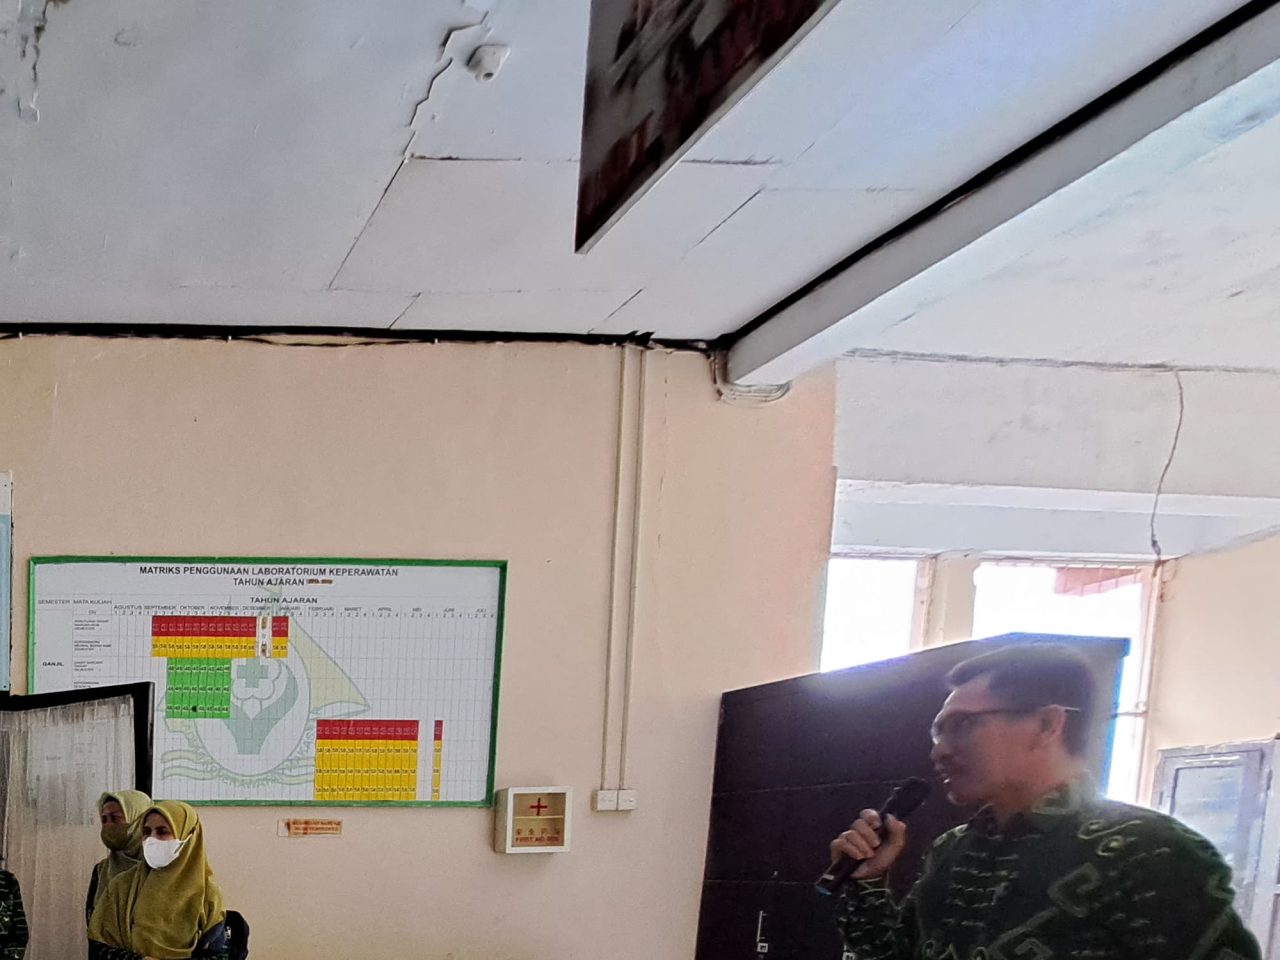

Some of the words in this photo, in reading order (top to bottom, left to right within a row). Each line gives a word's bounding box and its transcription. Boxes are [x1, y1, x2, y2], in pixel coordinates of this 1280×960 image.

[139, 565, 181, 576] MATRIKS
[183, 566, 250, 578] PENGGUNAAN
[251, 567, 327, 578] LABORATORIUM
[328, 568, 399, 579] KEPERAWATAN
[233, 577, 264, 587] TAHUN
[266, 578, 305, 588] AJARAN
[250, 596, 280, 605] TAHUN
[281, 596, 318, 605] AJARAN
